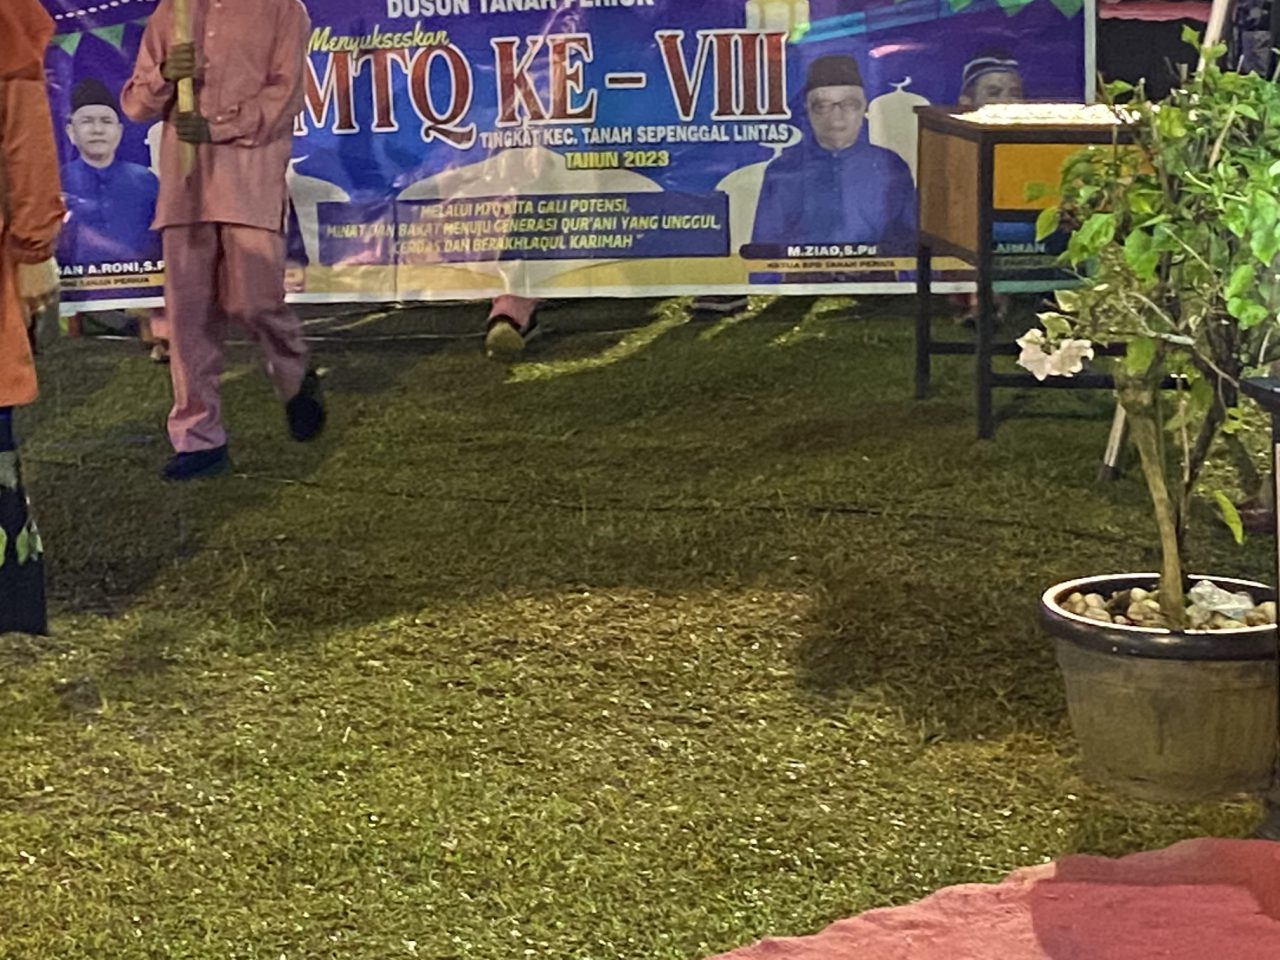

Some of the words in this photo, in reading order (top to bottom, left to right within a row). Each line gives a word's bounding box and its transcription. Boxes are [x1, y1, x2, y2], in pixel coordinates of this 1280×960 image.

[306, 20, 450, 61] Menyukseskan
[292, 42, 477, 151] MTQ
[490, 33, 598, 127] KE
[655, 27, 792, 122] VIII
[480, 129, 541, 149] TINGKAT
[543, 128, 579, 146] KEC.
[582, 126, 633, 145] TANAH
[636, 125, 731, 143] SEPENGGAL
[733, 124, 790, 142] LINTAS
[564, 152, 620, 169] TAHUN
[623, 150, 670, 168] 2023
[537, 200, 569, 214] GALI
[398, 222, 441, 237] BAKAT
[442, 220, 491, 237] MENUJU
[492, 218, 558, 233] GENERASI
[560, 216, 618, 233] QUR'ANI
[621, 216, 659, 230] YANG
[472, 235, 567, 252] BERAKHLAQUL
[569, 233, 633, 249] KARIMAH
